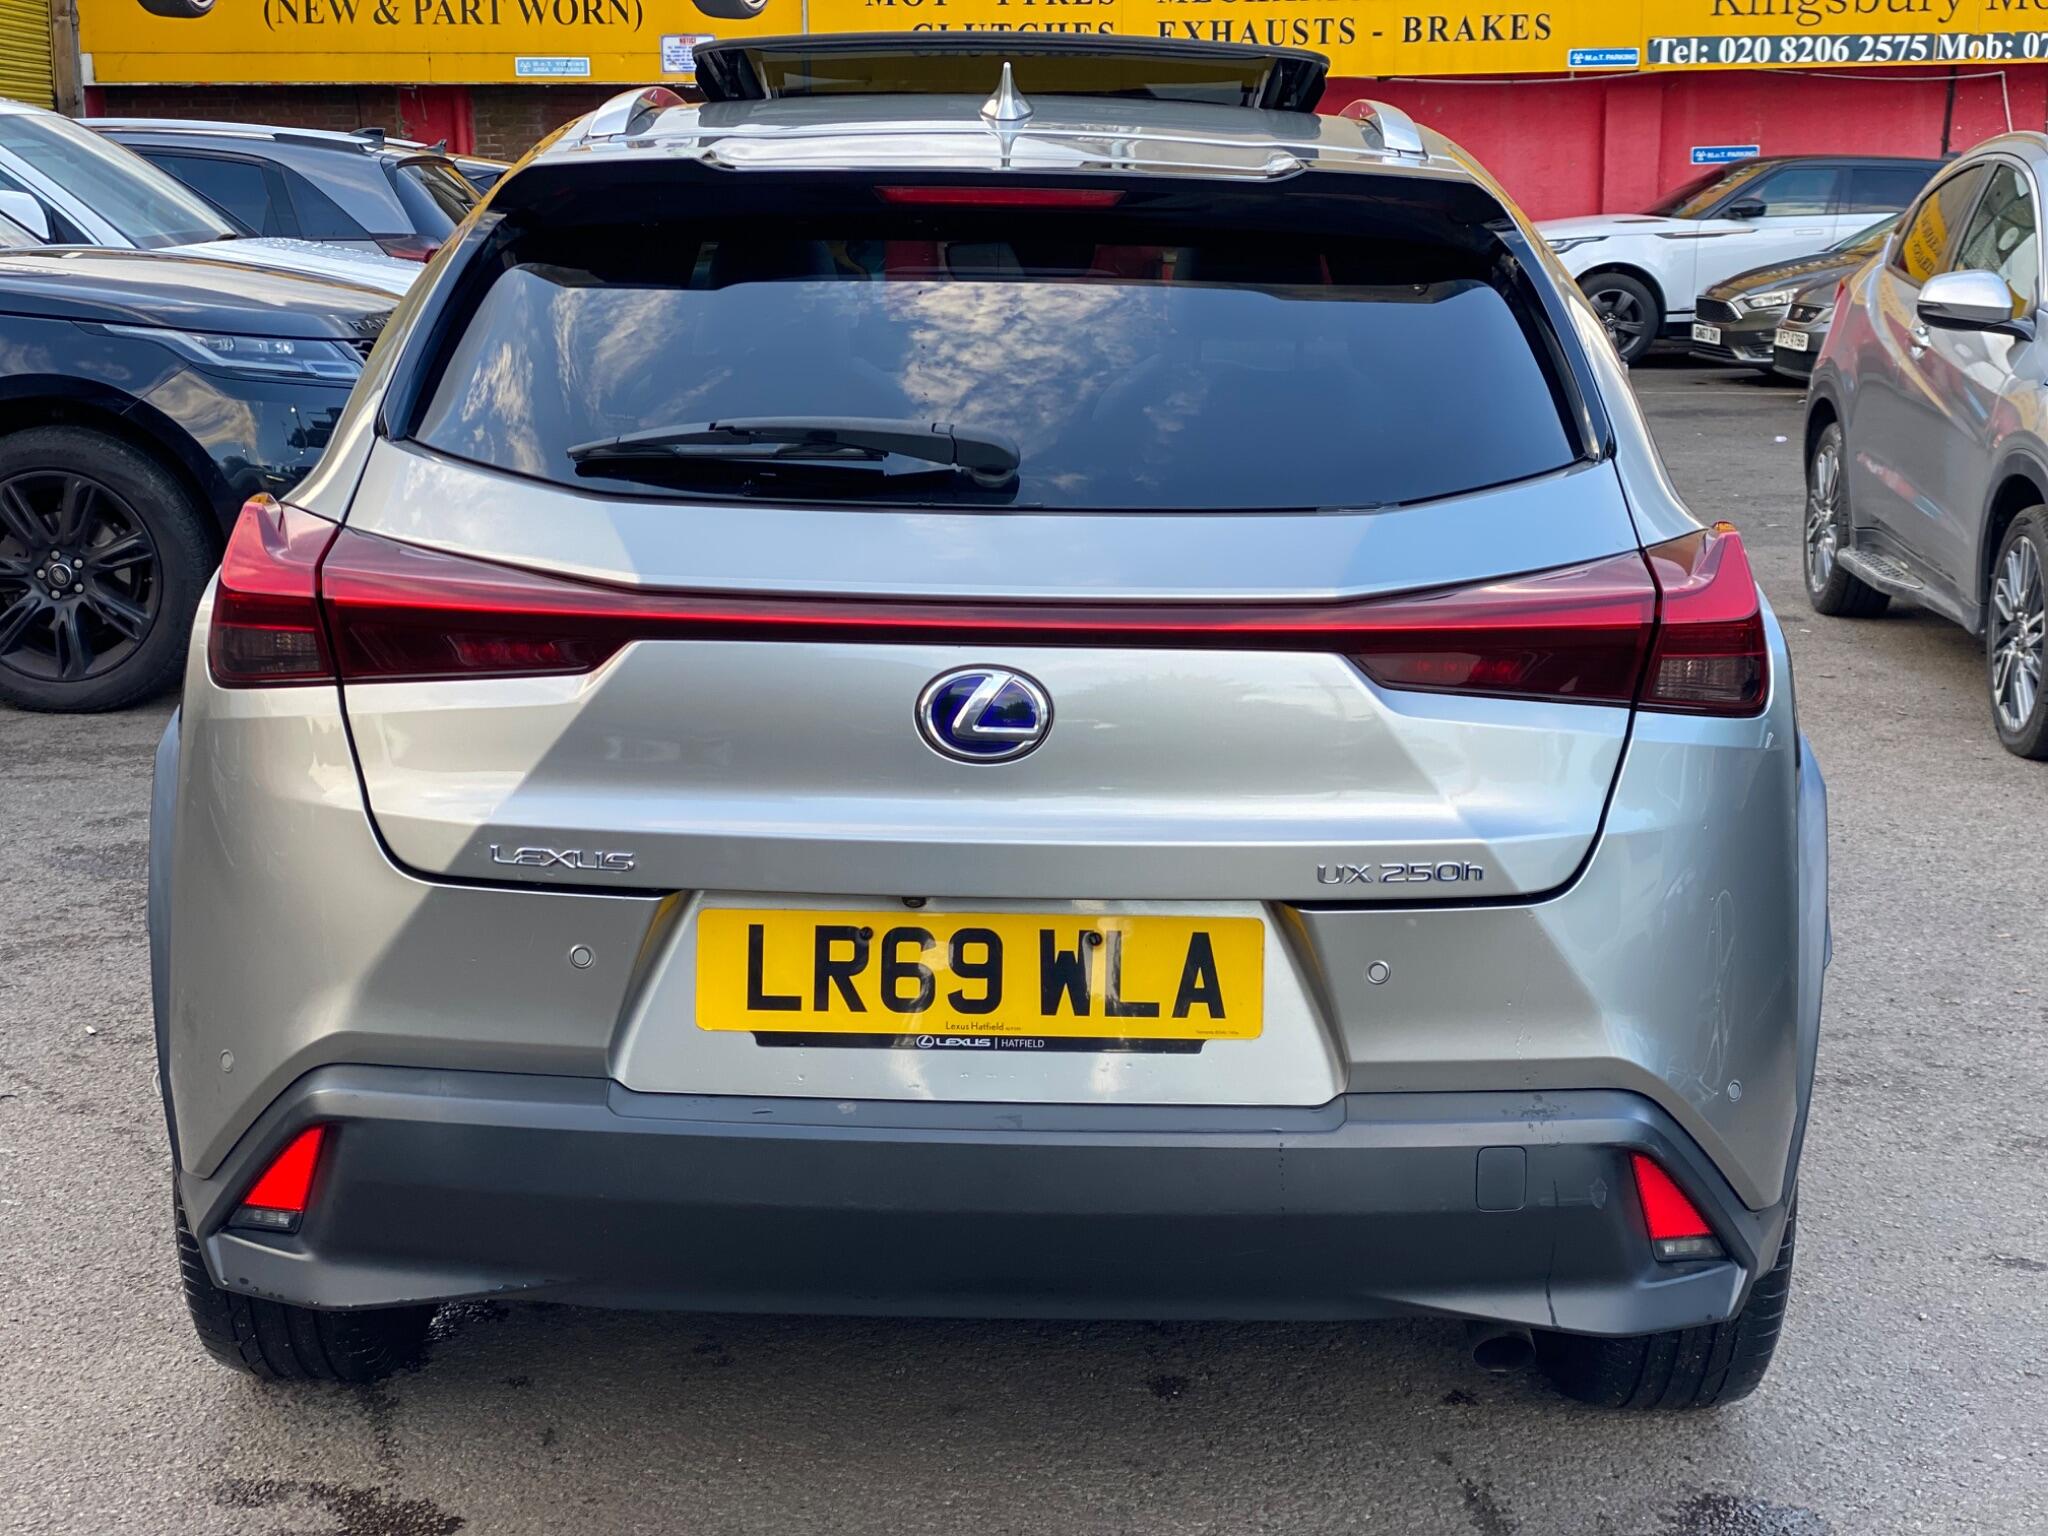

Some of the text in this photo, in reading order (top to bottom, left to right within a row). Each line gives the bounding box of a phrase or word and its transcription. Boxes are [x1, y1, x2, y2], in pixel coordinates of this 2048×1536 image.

[263, 0, 643, 32] (NEW & PART WORN)
[1157, 17, 1355, 46] EXHAUSTS
[1402, 14, 1551, 43] BRAKES
[1653, 38, 1709, 64] Tel:
[1718, 37, 1772, 64] 020
[1779, 36, 1850, 63] 8206
[1857, 35, 1928, 62] 2575
[1937, 33, 2013, 60] Mob:
[489, 844, 635, 872] LEXUS
[1317, 860, 1484, 885] UX 250h
[747, 923, 1226, 1018] LR69 WLA
[945, 1021, 969, 1030] Lexus
[971, 1021, 1004, 1031] Hatfield
[936, 1038, 1045, 1048] LEXUS HATFIELD
